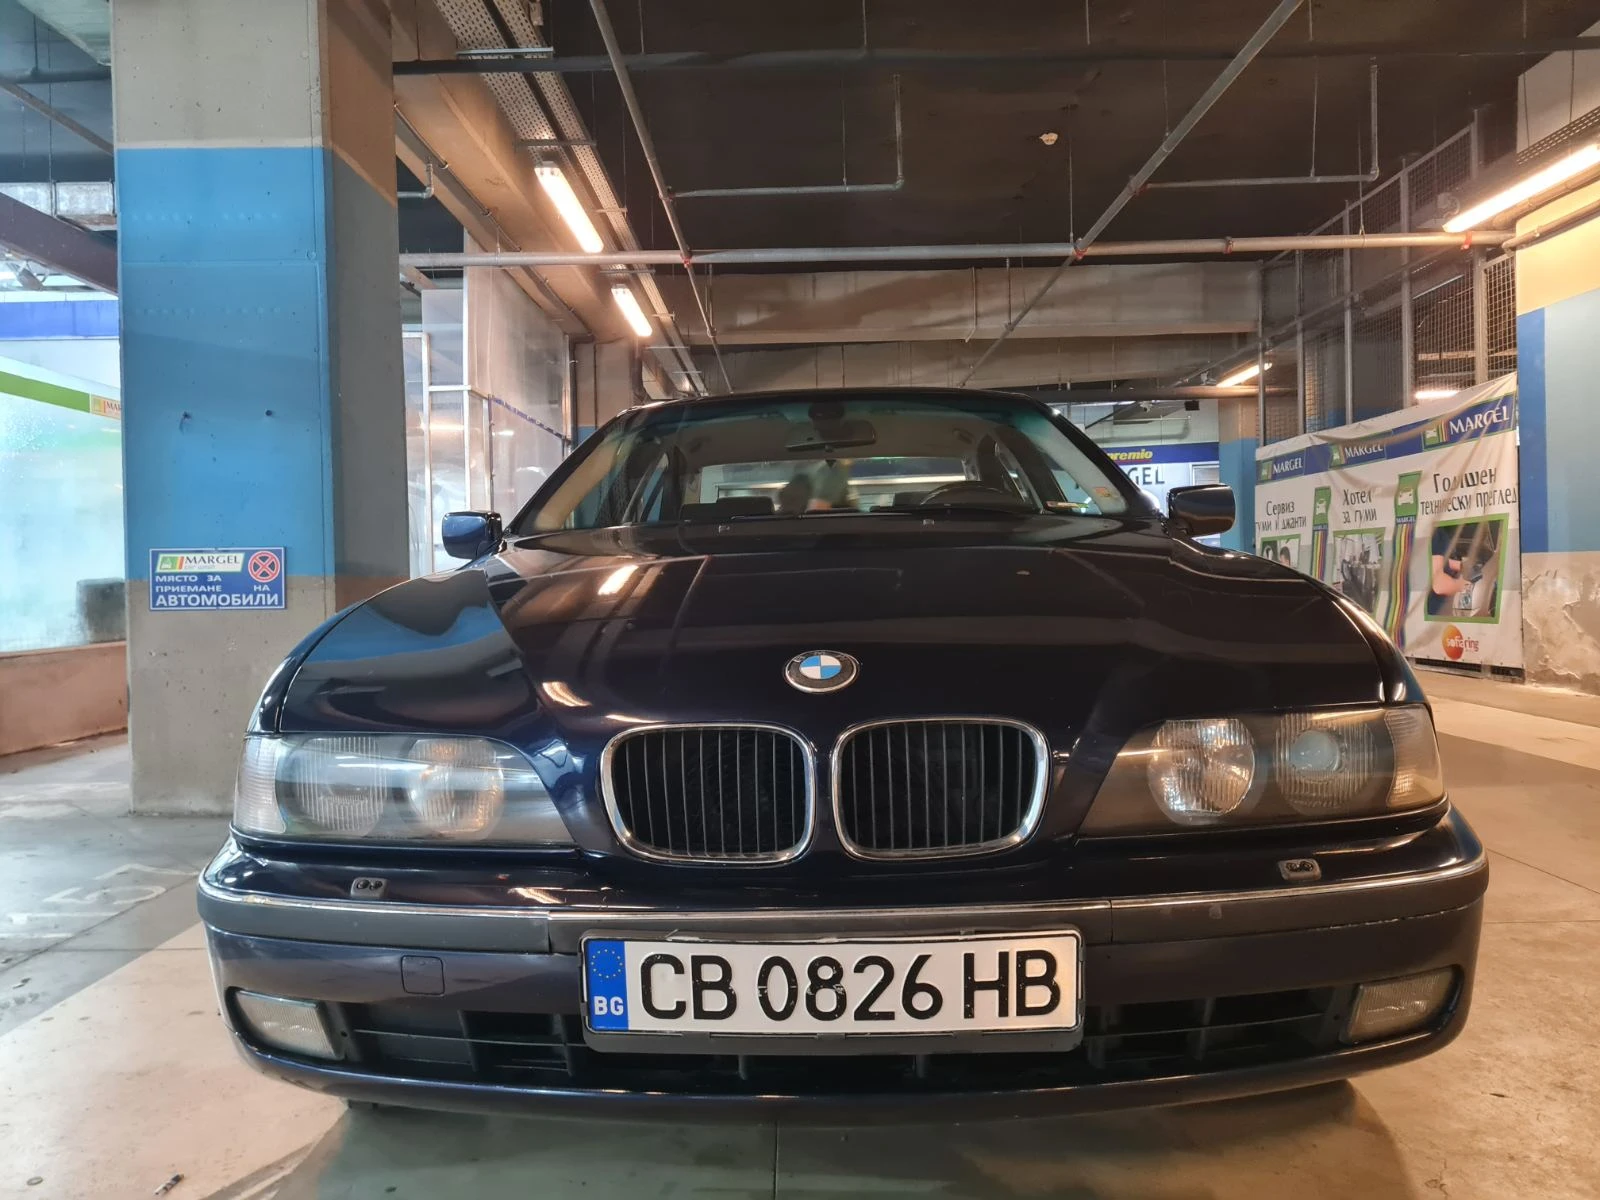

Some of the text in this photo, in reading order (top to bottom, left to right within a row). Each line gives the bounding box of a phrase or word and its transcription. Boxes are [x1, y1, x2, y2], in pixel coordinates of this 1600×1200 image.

[1449, 405, 1509, 435] MARGEL
[1272, 458, 1303, 475] MARGEL
[1342, 488, 1372, 506] Хотел
[1266, 500, 1295, 519] Сервиз
[1342, 508, 1377, 524] за гуми
[1281, 516, 1307, 530] джанти
[185, 555, 240, 564] MARGEL
[155, 585, 222, 593] ПРИЕМАНЕ
[155, 593, 279, 607] АВТОМОБИЛИ
[640, 949, 1062, 1021] CB 0826 HB
[594, 995, 624, 1015] BG
